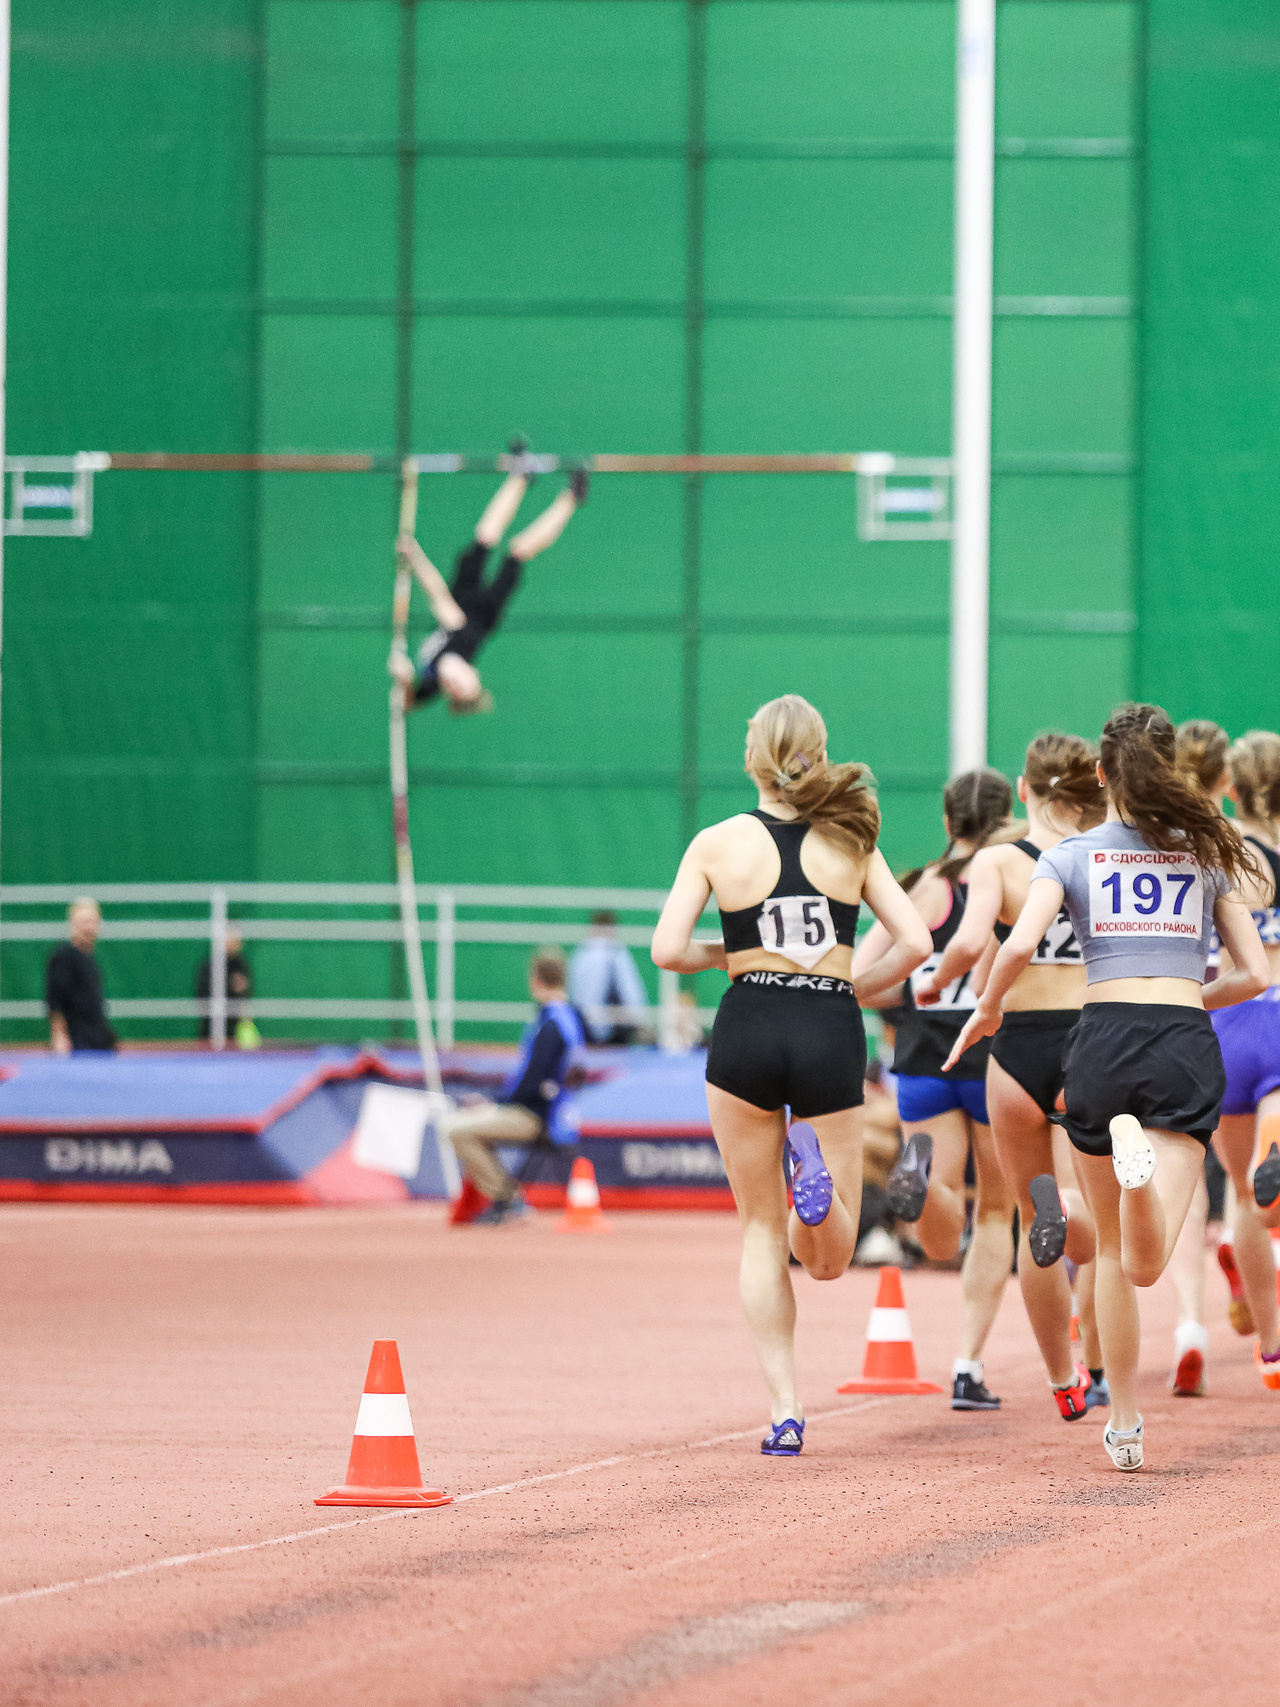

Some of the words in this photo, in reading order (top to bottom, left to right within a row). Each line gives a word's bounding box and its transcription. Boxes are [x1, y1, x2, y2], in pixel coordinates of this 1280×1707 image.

[1102, 872, 1195, 915] 197
[1096, 922, 1160, 932] МОСКОВСКОГО
[1164, 921, 1197, 934] РАЙОНА
